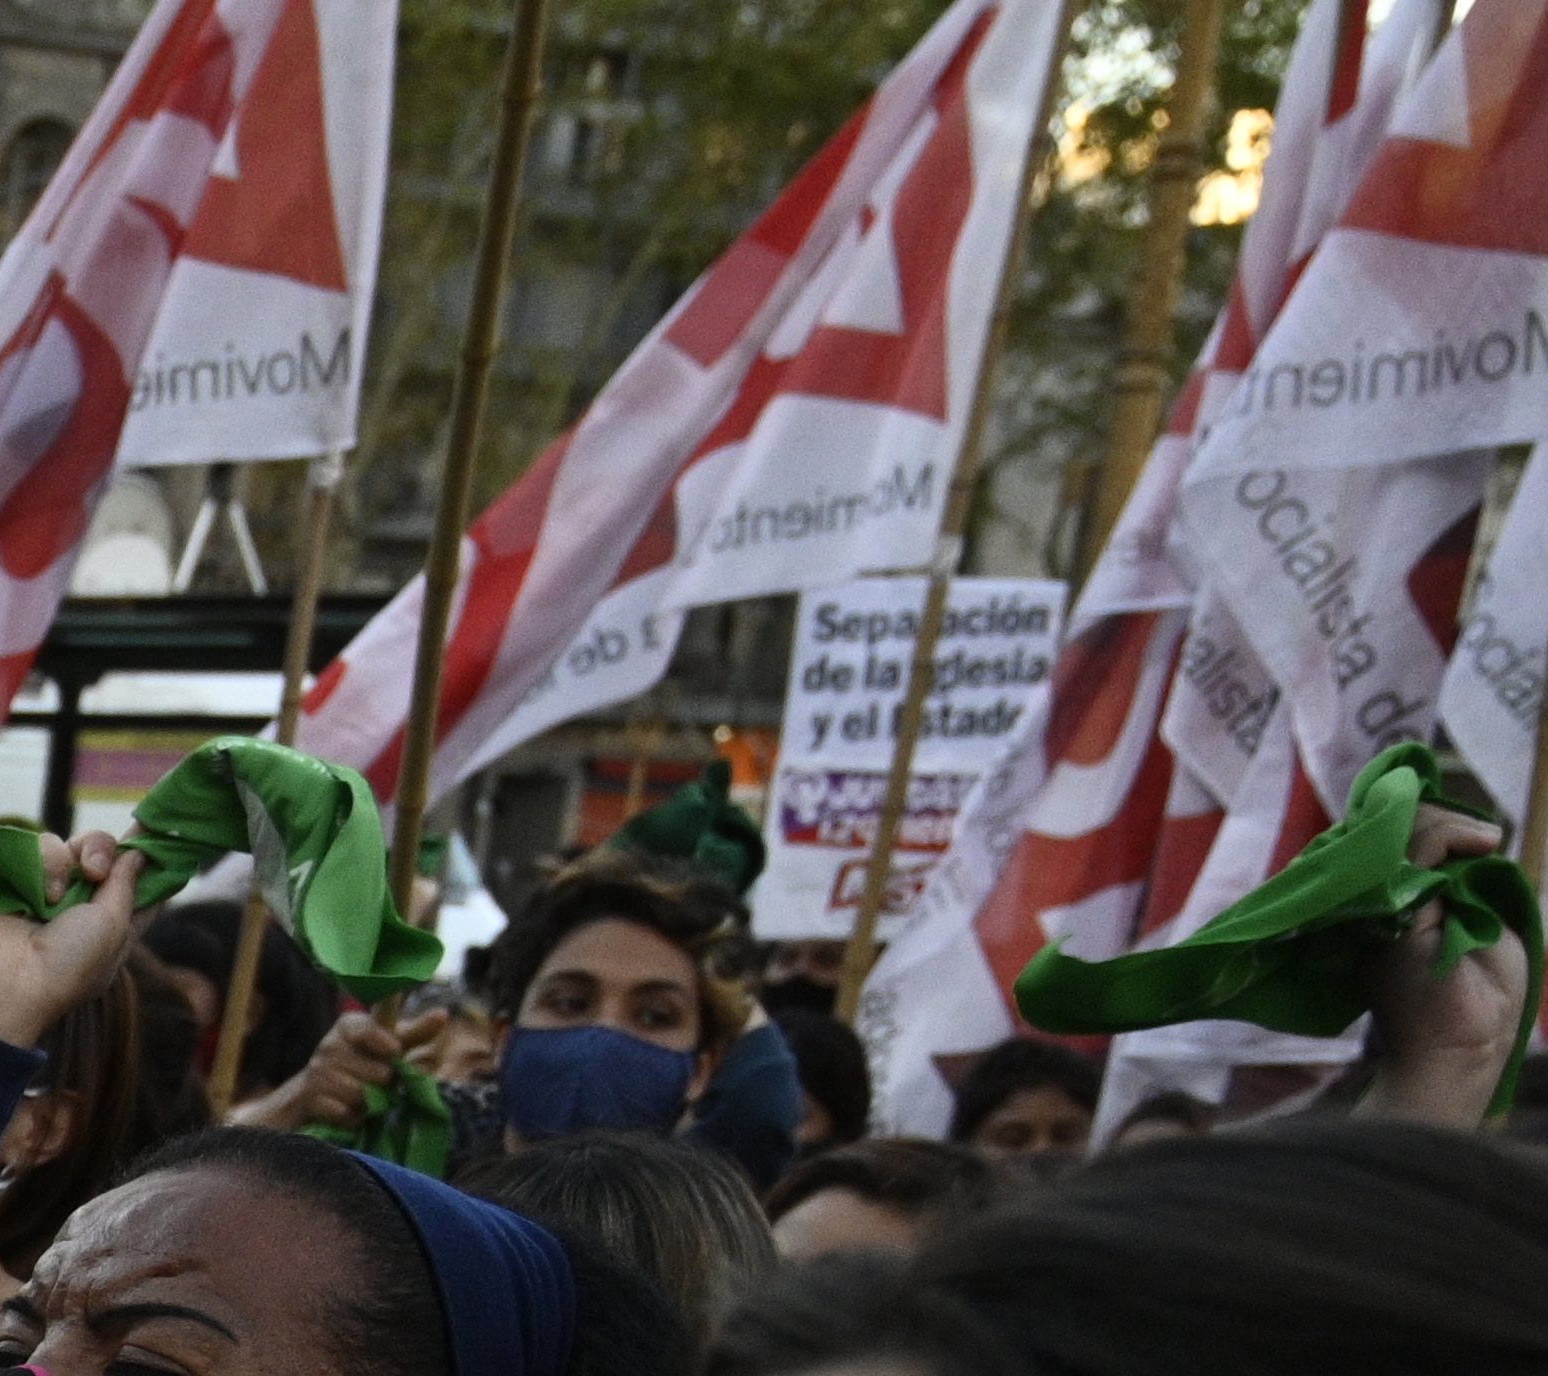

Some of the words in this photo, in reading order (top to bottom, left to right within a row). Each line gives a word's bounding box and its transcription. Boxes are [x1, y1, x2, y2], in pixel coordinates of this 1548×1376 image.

[814, 598, 1050, 645] Sepaación
[803, 652, 854, 692] de
[865, 655, 901, 689] la
[930, 646, 1049, 695] glesia
[811, 712, 832, 750] y
[842, 704, 878, 741] el
